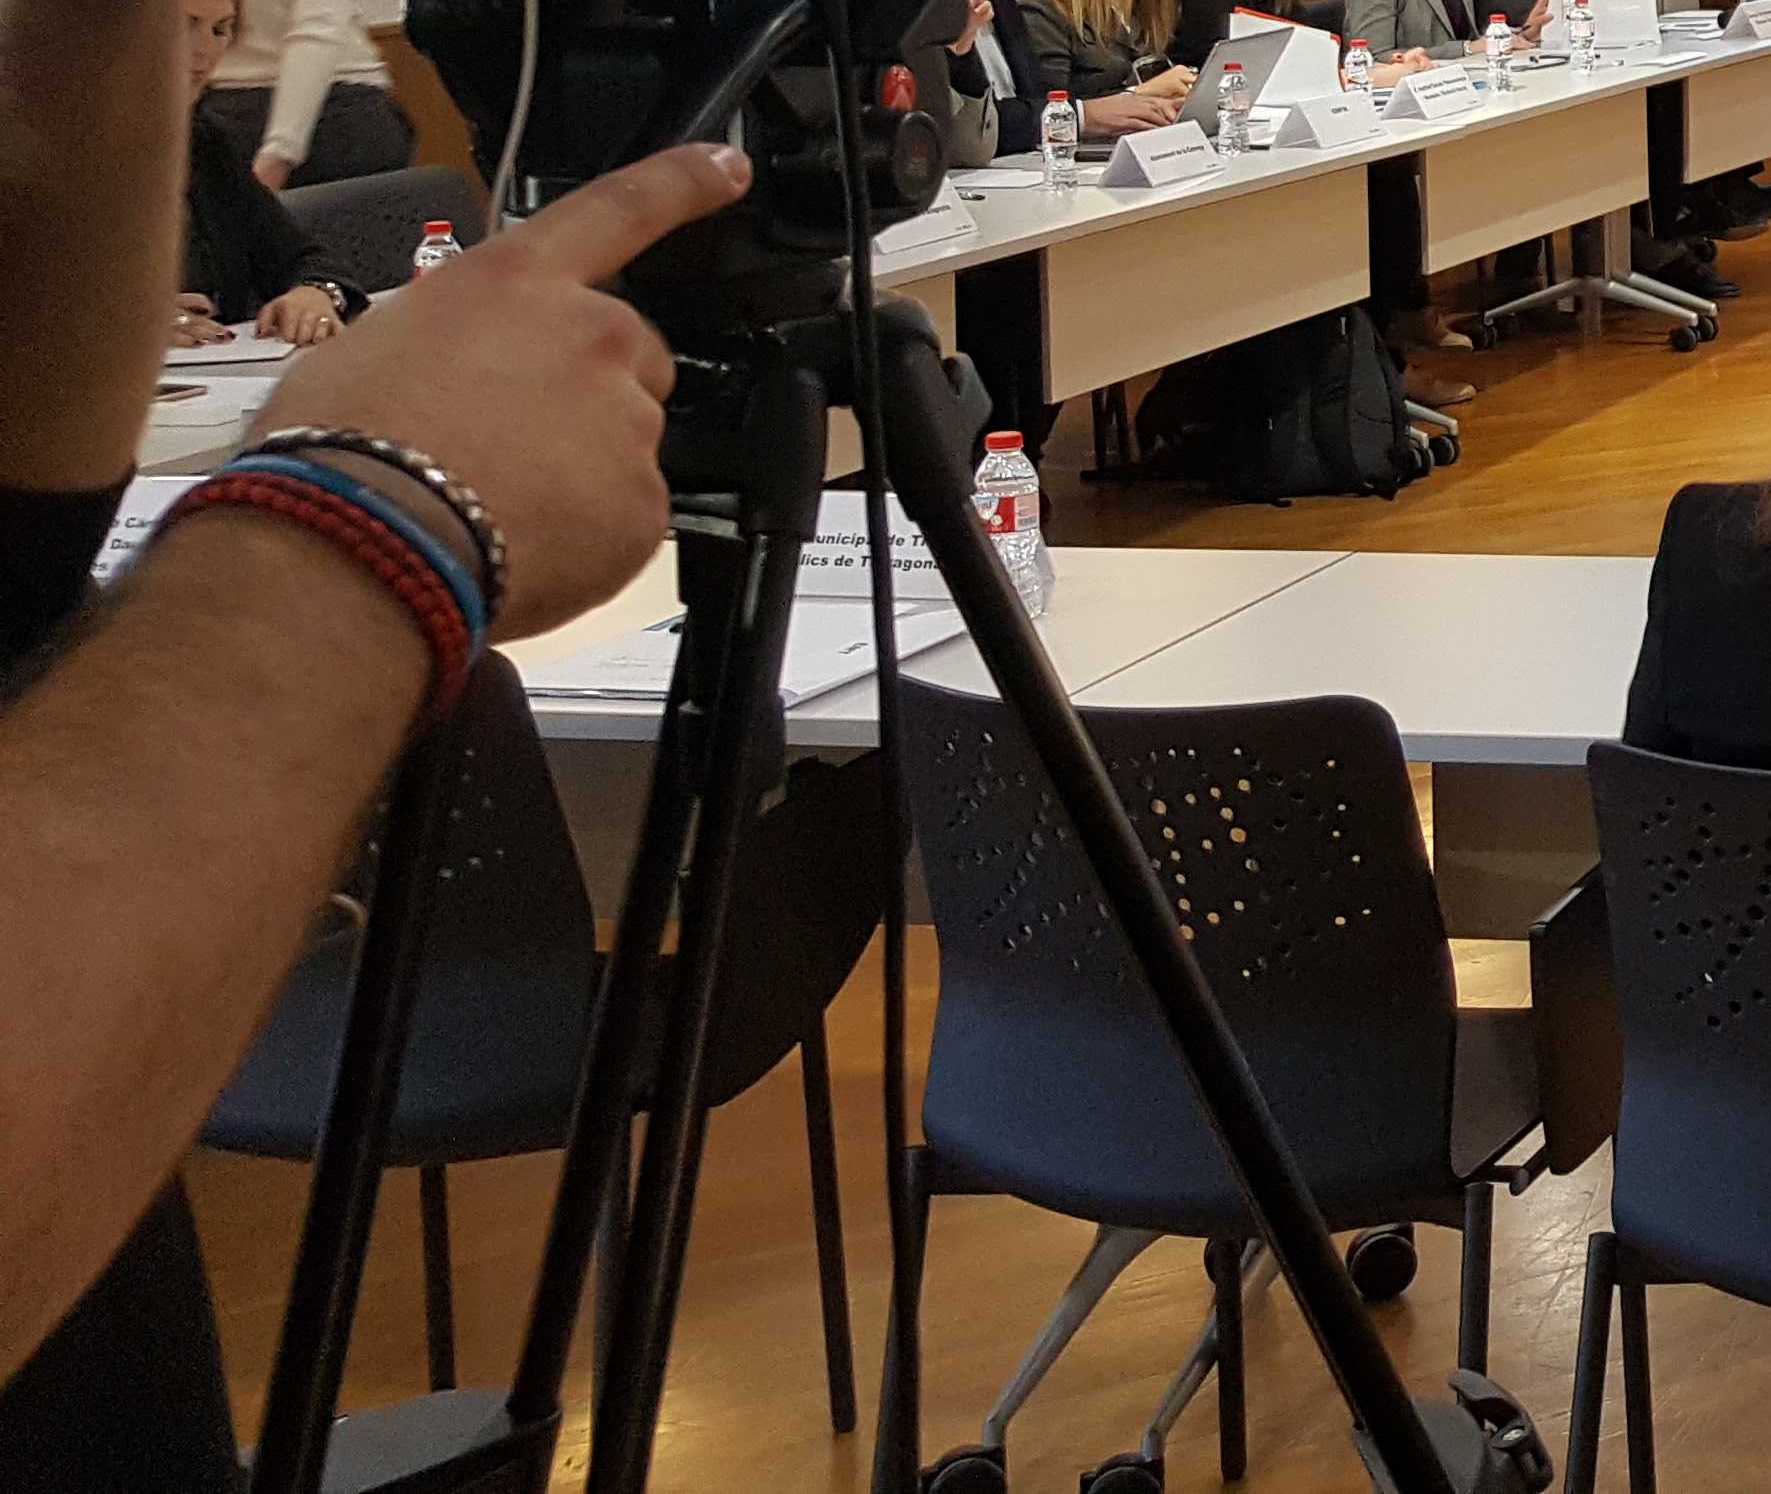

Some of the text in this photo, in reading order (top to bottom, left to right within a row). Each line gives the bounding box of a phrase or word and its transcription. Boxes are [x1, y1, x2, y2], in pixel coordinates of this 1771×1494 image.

[809, 533, 870, 548] unicip
[834, 554, 854, 567] de
[860, 556, 939, 571] Tagon
